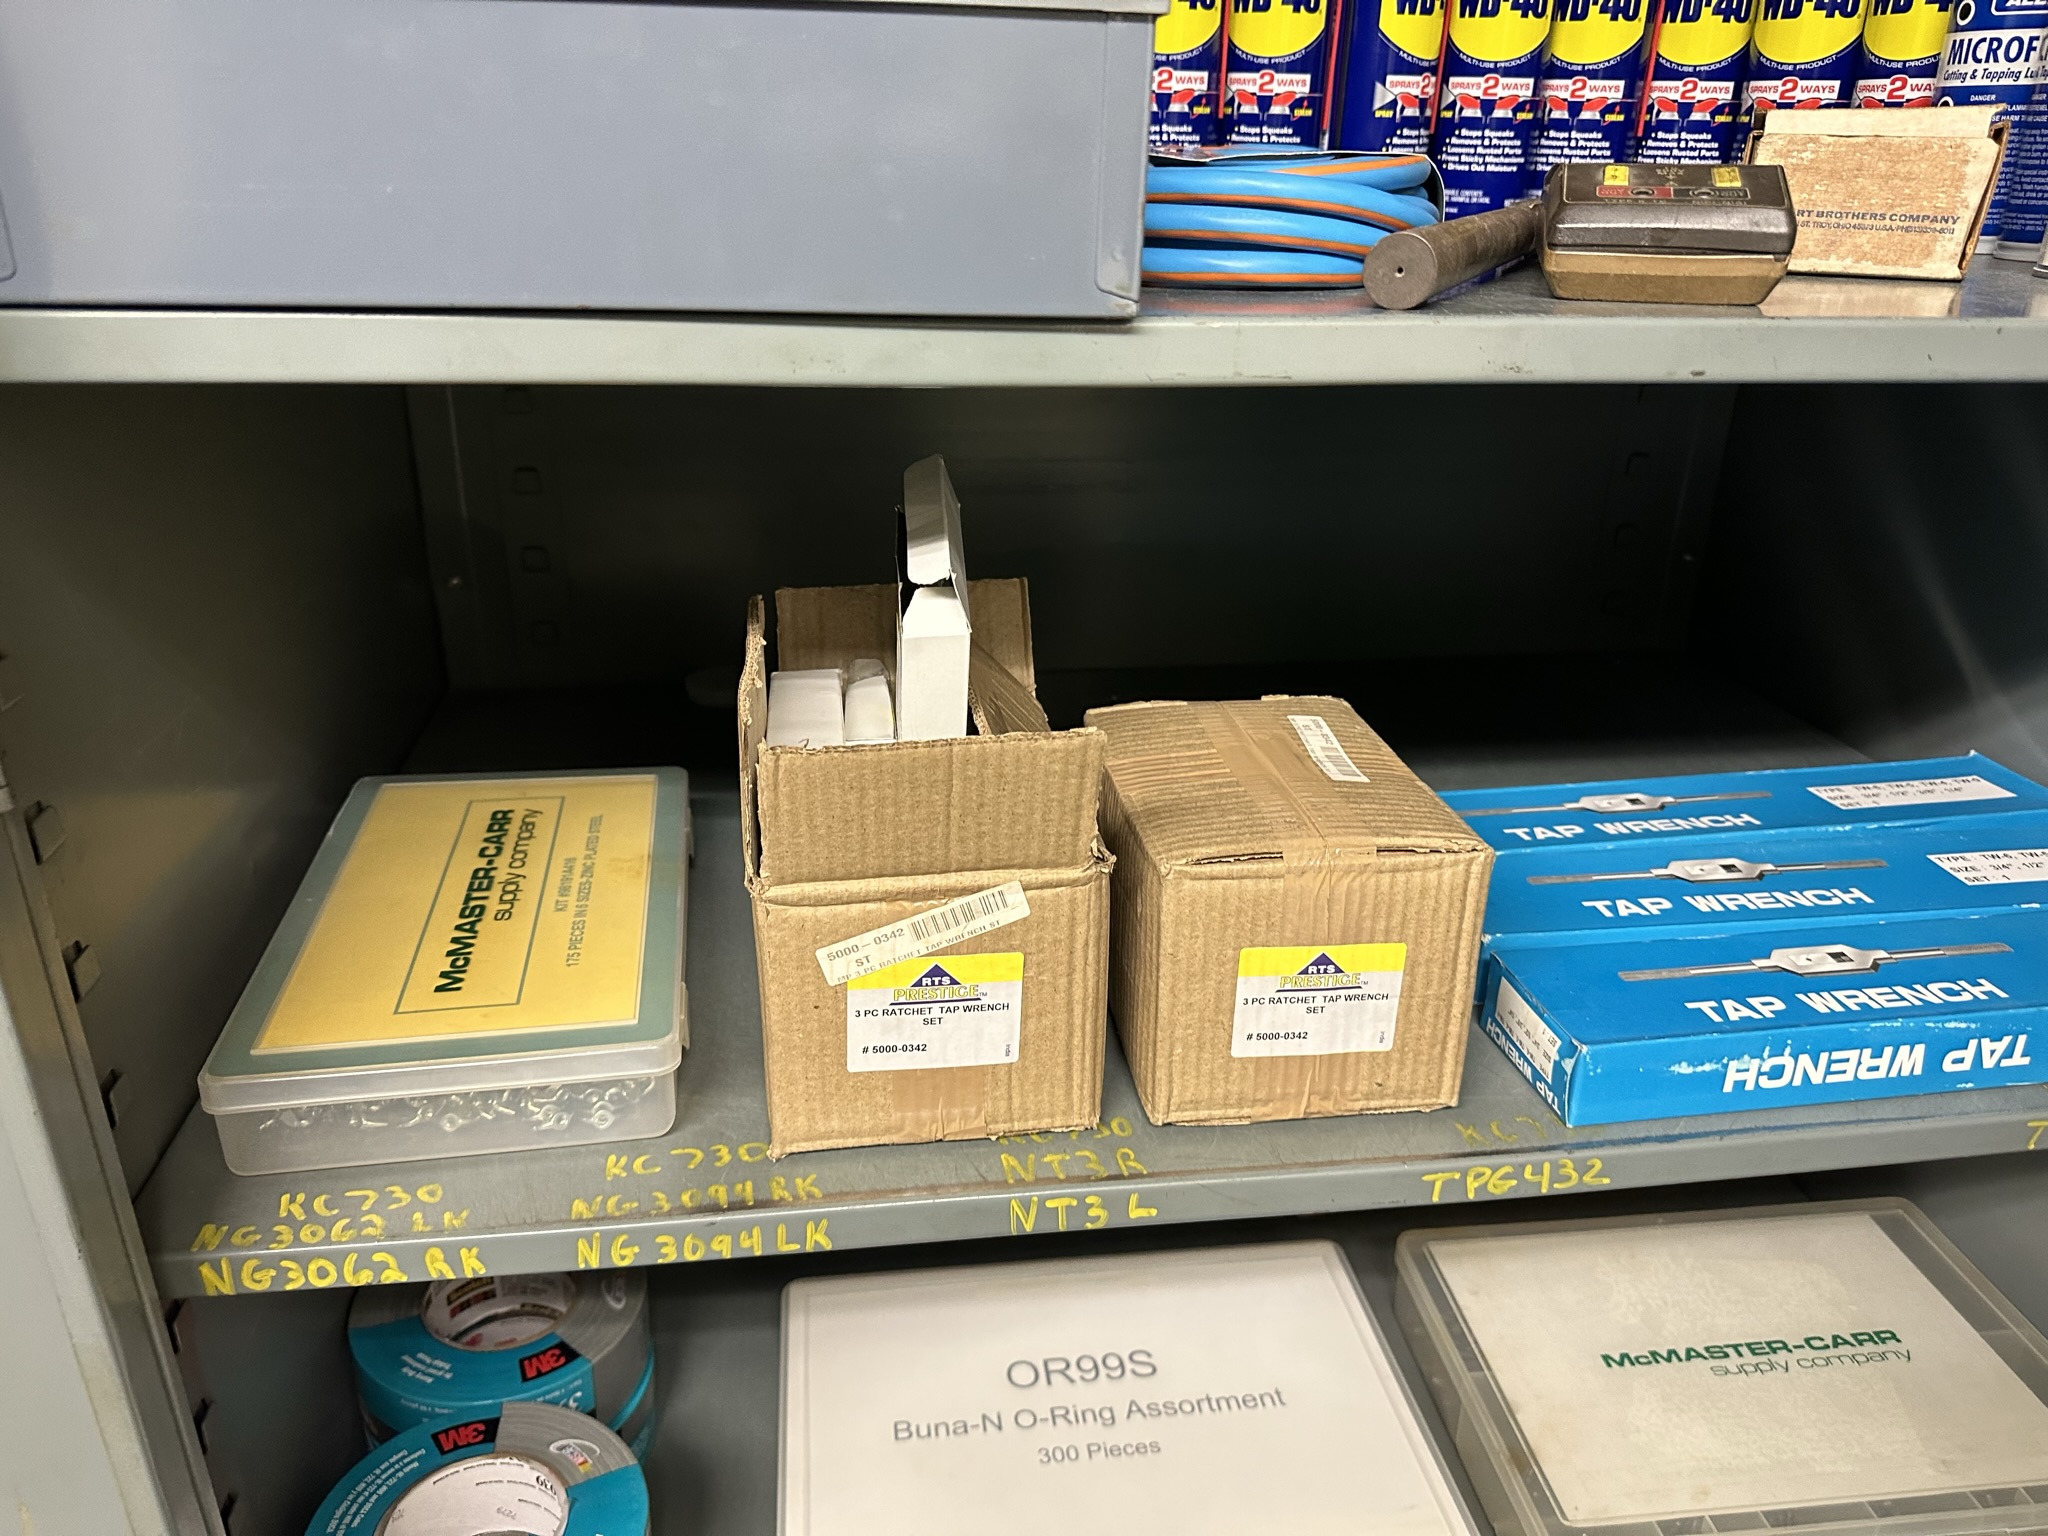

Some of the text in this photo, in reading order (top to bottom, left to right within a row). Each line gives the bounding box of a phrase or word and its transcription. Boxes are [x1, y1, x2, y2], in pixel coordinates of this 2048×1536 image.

[1459, 53, 1532, 68] MULTI-USE PRODUCT
[1869, 54, 1903, 68] MULTI-USE
[1947, 36, 2040, 66] MICROF
[1585, 57, 1621, 71] PRODUCT
[1659, 58, 1732, 72] MULTI-USE PRODUCT
[1760, 55, 1837, 70] MULTI-USE PRODUCT
[1157, 69, 1205, 91] 2 WAYS
[1228, 72, 1306, 93] SPRAYS 2 WAYS
[1389, 74, 1431, 96] SPRAYS 2
[1450, 76, 1530, 97] SPRAYS 2 WAYS
[1944, 70, 1968, 84] Cutting
[1970, 69, 1978, 80] &
[1981, 68, 2022, 82] Tapping
[1570, 78, 1587, 99] 2
[1589, 86, 1620, 94] WAYS
[1680, 80, 1698, 100] 2
[1700, 86, 1730, 94] WAYS
[1750, 78, 1835, 100] SPRAYS 2 WAYS
[1858, 77, 1907, 100] SPRAYS 2
[1970, 94, 1996, 102] DANGER
[1816, 210, 1960, 224] BROTHERS COMPANY
[1502, 813, 1762, 840] TAP WRENCH
[494, 808, 543, 921] supply company
[434, 810, 514, 992] McMASTER-CARR
[1582, 887, 1874, 918] TAP WRENCH
[570, 920, 586, 951] PIECES
[864, 966, 876, 976] PC
[879, 949, 921, 968] RATCHET
[924, 941, 943, 952] TAP
[944, 924, 986, 945] WRENCH
[989, 920, 1001, 930] ST
[566, 952, 580, 967] 175
[855, 955, 871, 968] ST
[1308, 964, 1336, 974] RTS
[922, 976, 950, 986] RTS
[1280, 973, 1360, 988] PRESTIGE
[894, 985, 978, 1001] PRESTIGE
[1243, 992, 1389, 1006] 3 PC RATCHET TAP WRENCH
[1685, 978, 2009, 1024] TAP WRENCH
[855, 1002, 1010, 1018] 3 PC RATCHET TAP WRENCH
[1306, 1006, 1326, 1014] SET
[922, 1016, 944, 1026] SET
[1246, 1032, 1308, 1041] # 5000-0342
[862, 1044, 928, 1054] # 5000-0342
[1486, 1018, 1532, 1082] WRENCH
[1723, 1034, 2031, 1093] TAP WRENCH
[1536, 1080, 1561, 1115] TAP
[1601, 1328, 1902, 1368] McMASTER-CARR
[522, 1348, 566, 1380] 3M
[1006, 1348, 1158, 1389] OR99S
[1710, 1348, 1912, 1377] supply company
[892, 1387, 1287, 1440] Buna-N O-Ring Assortment
[438, 1422, 486, 1452] 3M
[1038, 1438, 1162, 1464] 300 Pieces
